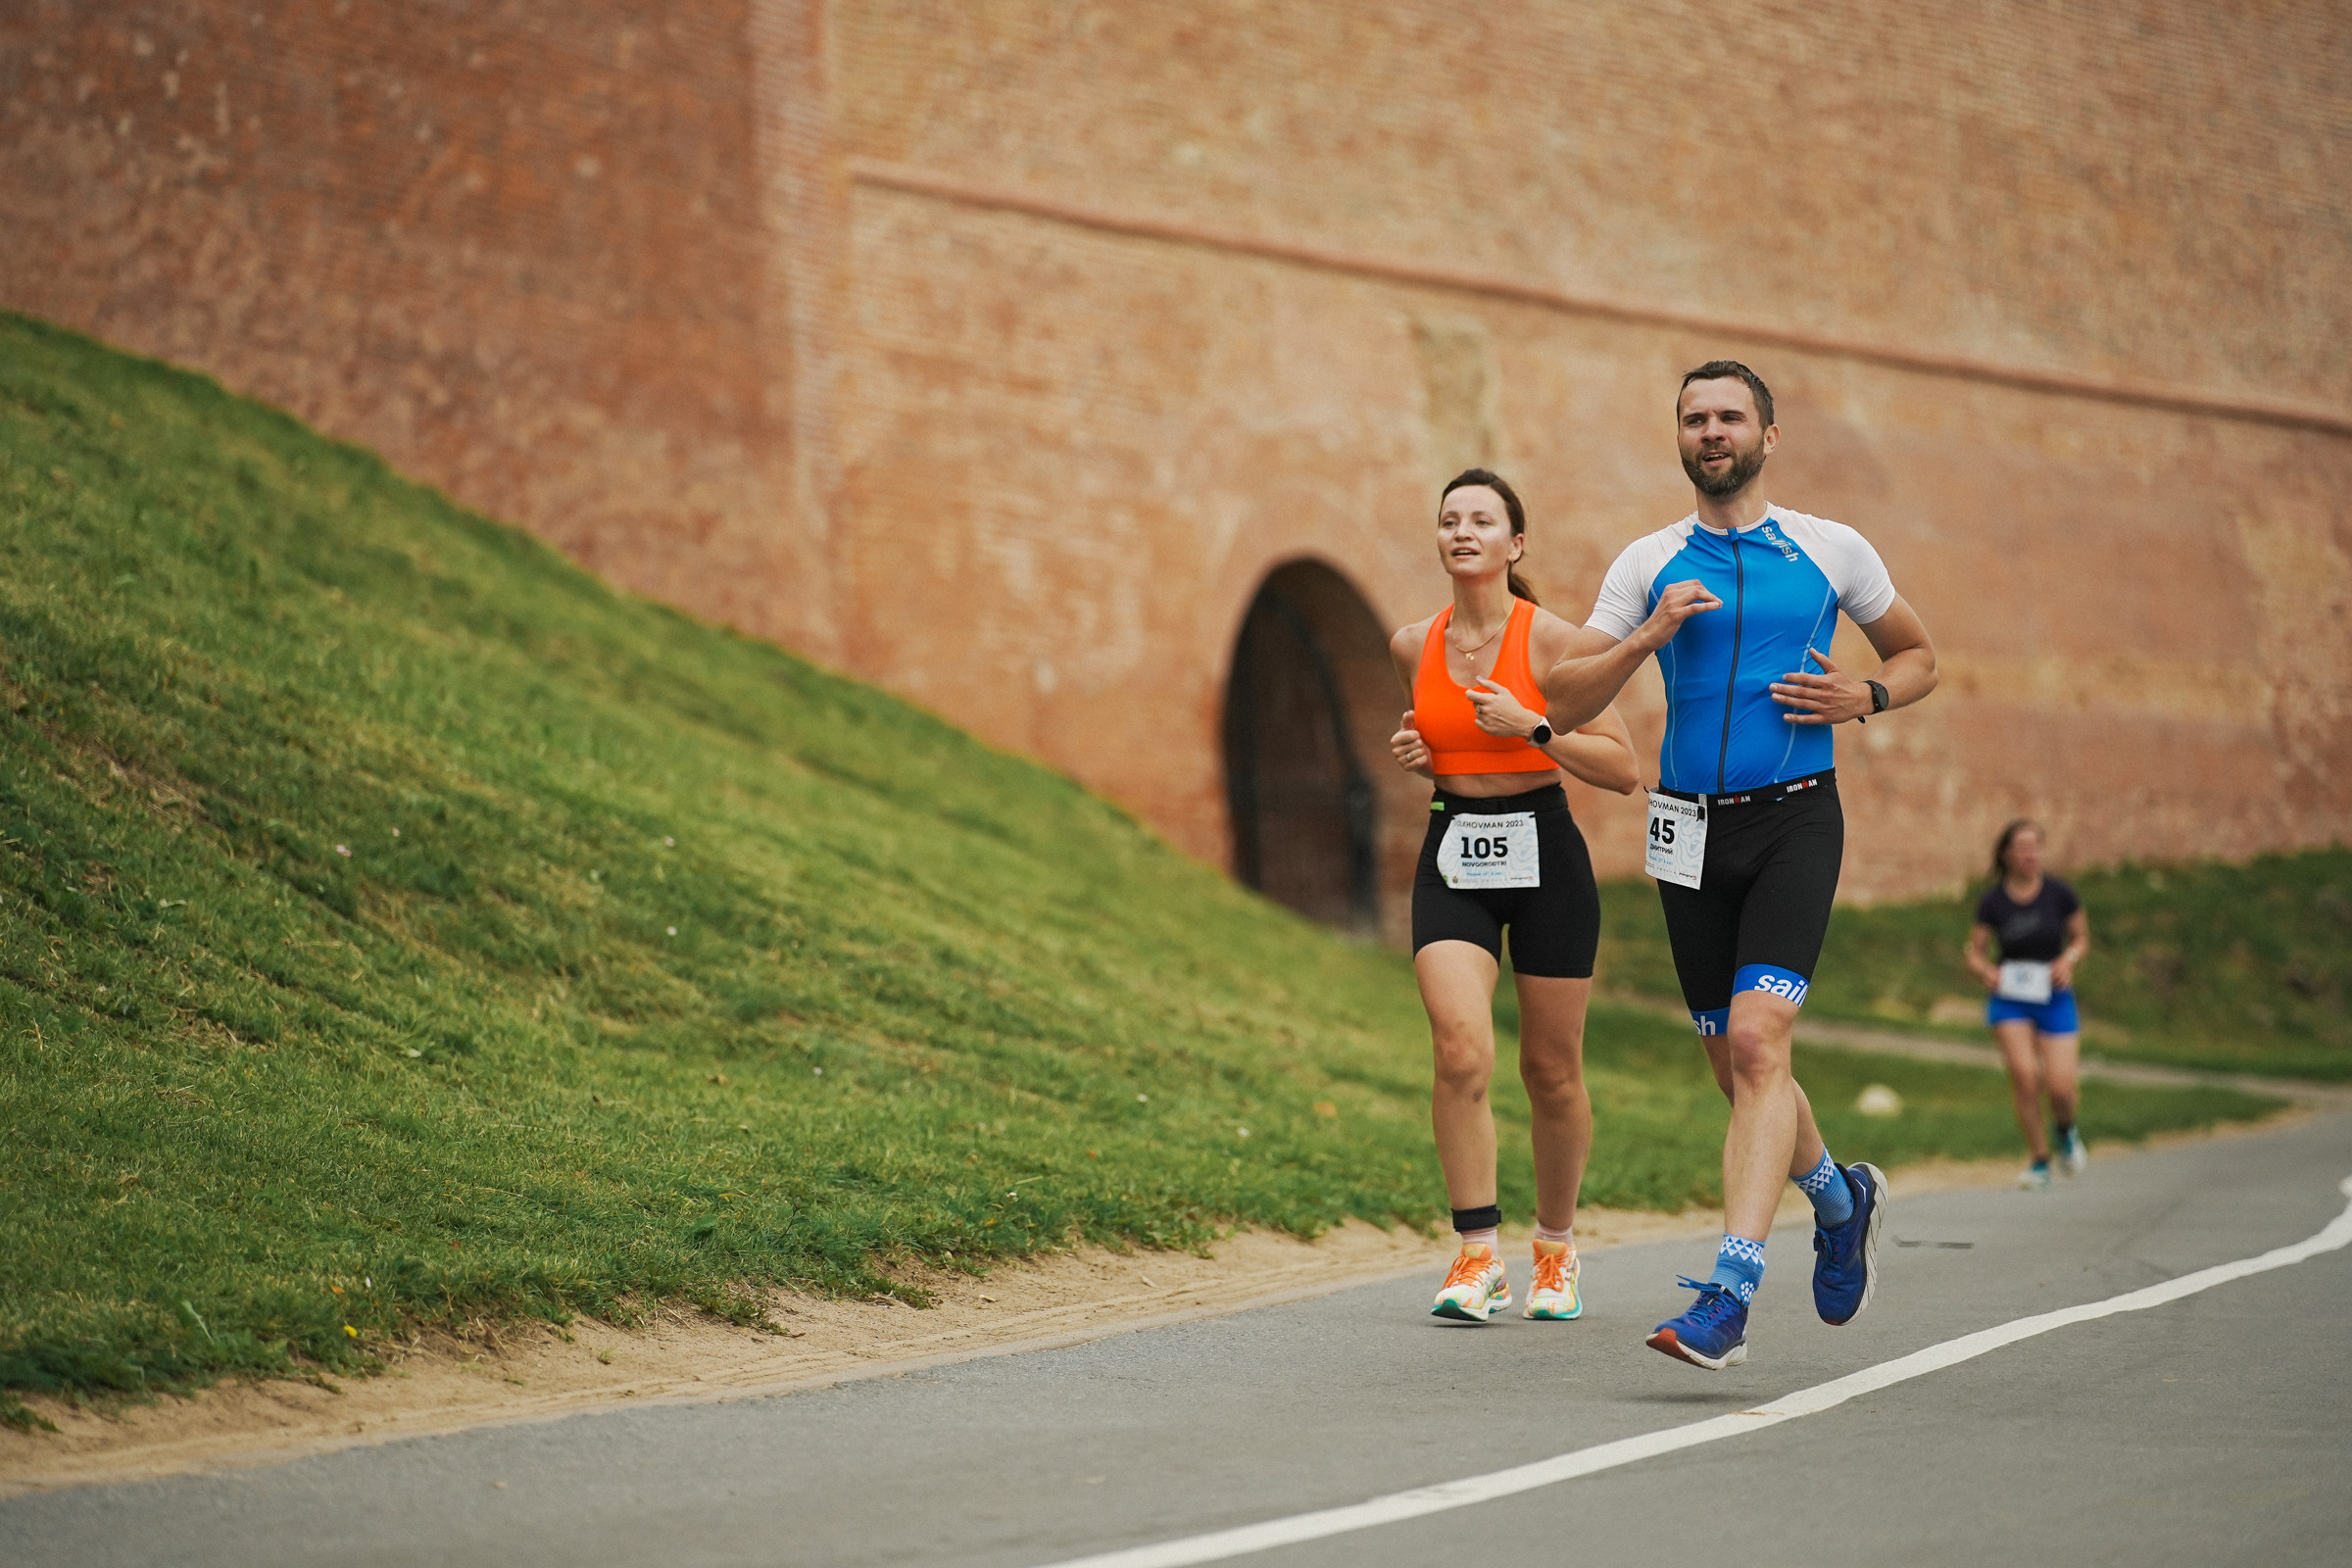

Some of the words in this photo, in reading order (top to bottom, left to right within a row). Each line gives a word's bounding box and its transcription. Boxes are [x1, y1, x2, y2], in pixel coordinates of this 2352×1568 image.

[1680, 807, 1696, 817] 2023
[1505, 819, 1524, 828] 2023
[1649, 816, 1676, 845] 45
[1460, 836, 1508, 859] 105
[1649, 843, 1674, 856] ДМИТРИЙ
[1753, 974, 1809, 1008] sail
